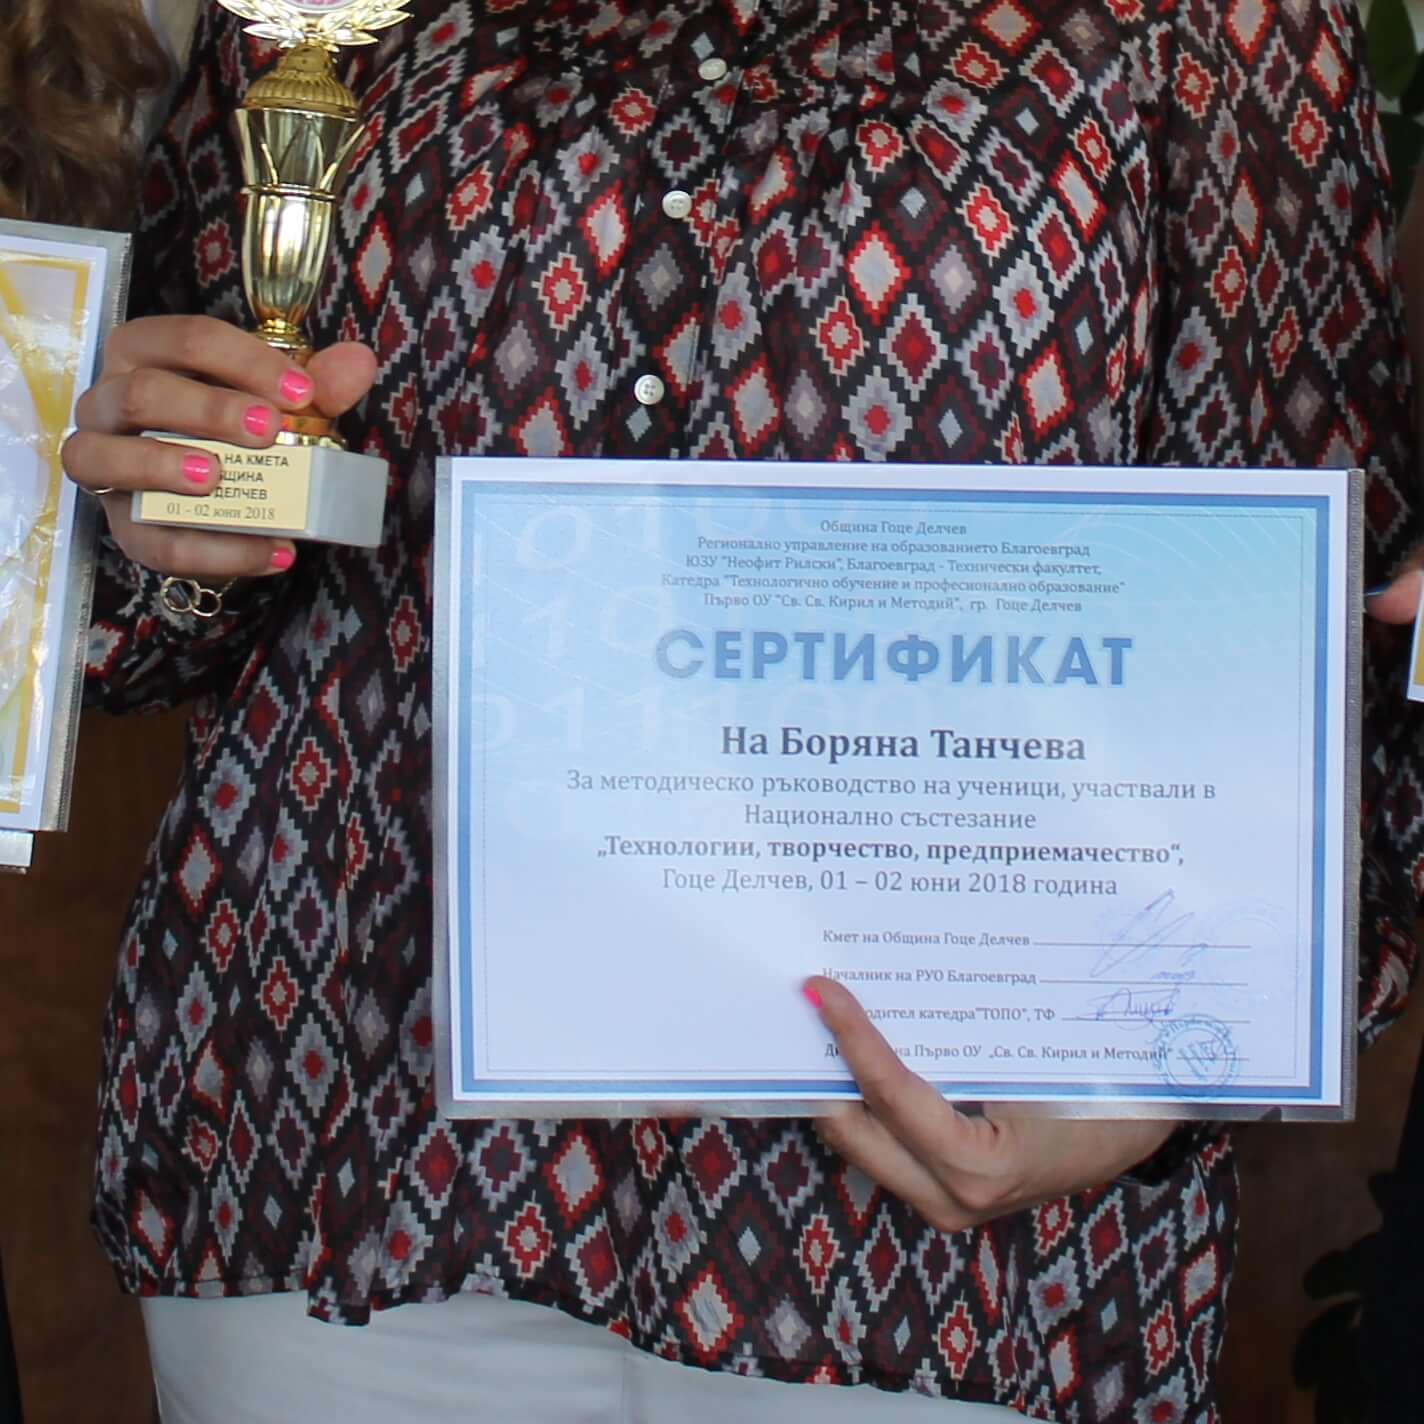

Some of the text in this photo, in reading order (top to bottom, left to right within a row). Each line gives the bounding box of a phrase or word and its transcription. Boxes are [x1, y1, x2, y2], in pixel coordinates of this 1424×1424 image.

[224, 453, 289, 467] НА КМЕТА
[219, 470, 264, 483] ЩИНА
[214, 486, 268, 500] ДЕЛЧЕВ
[167, 502, 180, 516] 01
[194, 504, 210, 517] 02
[213, 508, 241, 519] юни
[245, 506, 275, 521] 2018
[819, 519, 968, 537] Община Гоце Делчев
[697, 536, 1091, 559] Регионално управление на образованието Благоевград
[657, 630, 1133, 687] СЕРТИФИКАТ
[722, 726, 1085, 765] На Боряна Танчева
[567, 769, 593, 790] За
[601, 775, 755, 794] методическо
[762, 777, 917, 798] ръководство
[923, 779, 952, 796] на
[957, 780, 1066, 801] ученици,
[1071, 782, 1196, 802] участвали
[745, 804, 1037, 830] Национално състезание
[767, 841, 920, 863] творчество,
[663, 868, 716, 892] Гоце
[721, 868, 814, 893] Делчев,
[820, 869, 848, 891] 01
[874, 870, 903, 892] 02
[910, 876, 961, 893] юни
[968, 872, 1027, 894] 2018
[1033, 879, 1118, 898] година
[823, 929, 1031, 948] Кмет на Община Гоце Делчев
[895, 971, 913, 982] на
[915, 968, 945, 983] РУО
[947, 969, 1037, 986] Благоевград
